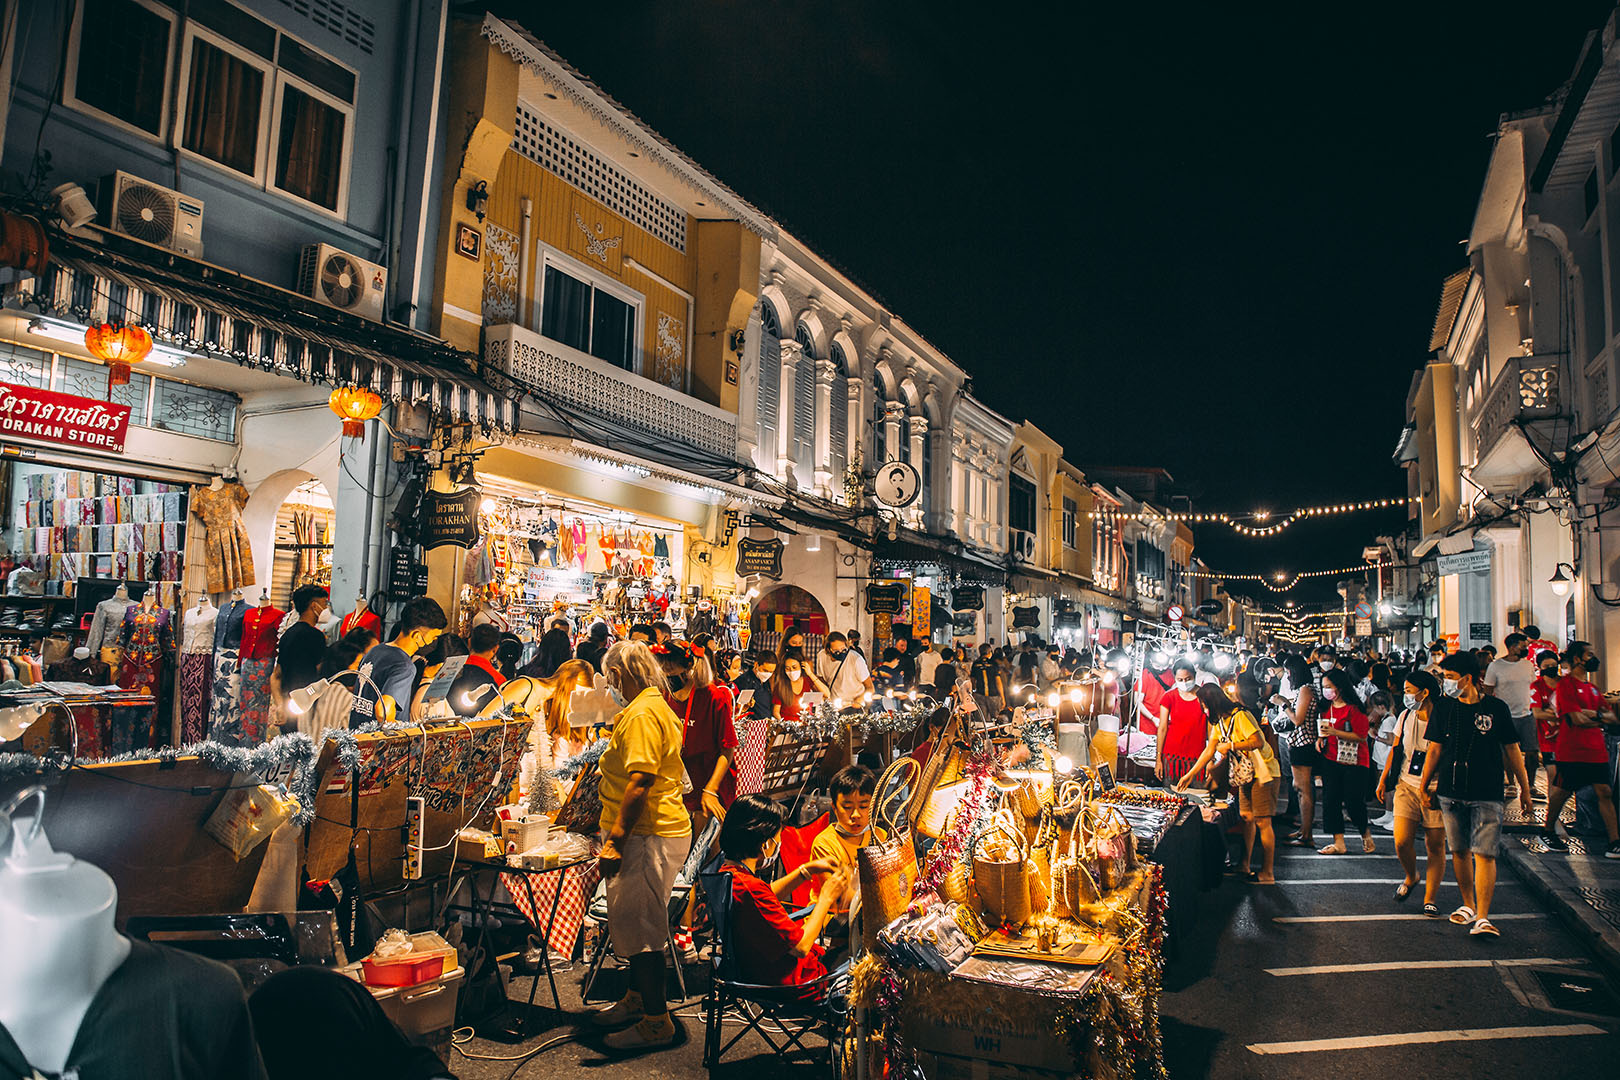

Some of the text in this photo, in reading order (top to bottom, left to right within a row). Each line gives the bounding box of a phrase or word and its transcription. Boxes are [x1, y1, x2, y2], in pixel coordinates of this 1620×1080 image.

[0, 416, 116, 447] ORAKAN STORE
[113, 443, 123, 453] 96
[428, 514, 471, 526] TORAKHAN
[973, 1035, 1001, 1054] WH
